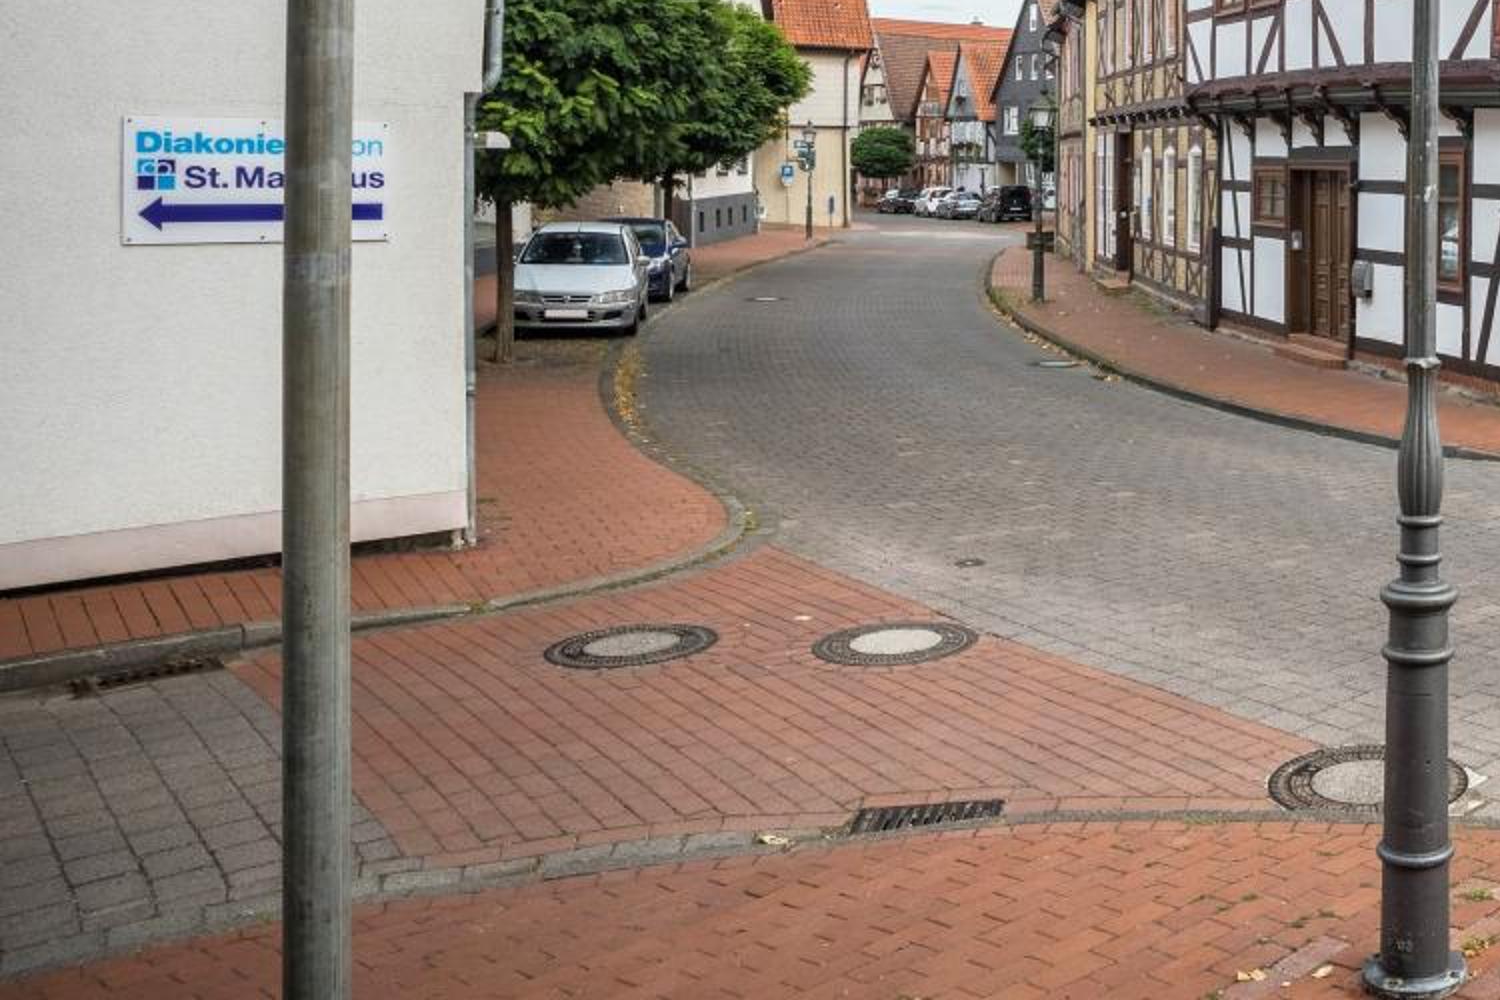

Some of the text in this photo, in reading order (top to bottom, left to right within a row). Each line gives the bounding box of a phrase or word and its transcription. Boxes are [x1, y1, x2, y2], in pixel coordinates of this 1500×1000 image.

[135, 131, 383, 157] Diakonieon
[184, 165, 385, 189] St. Maus
